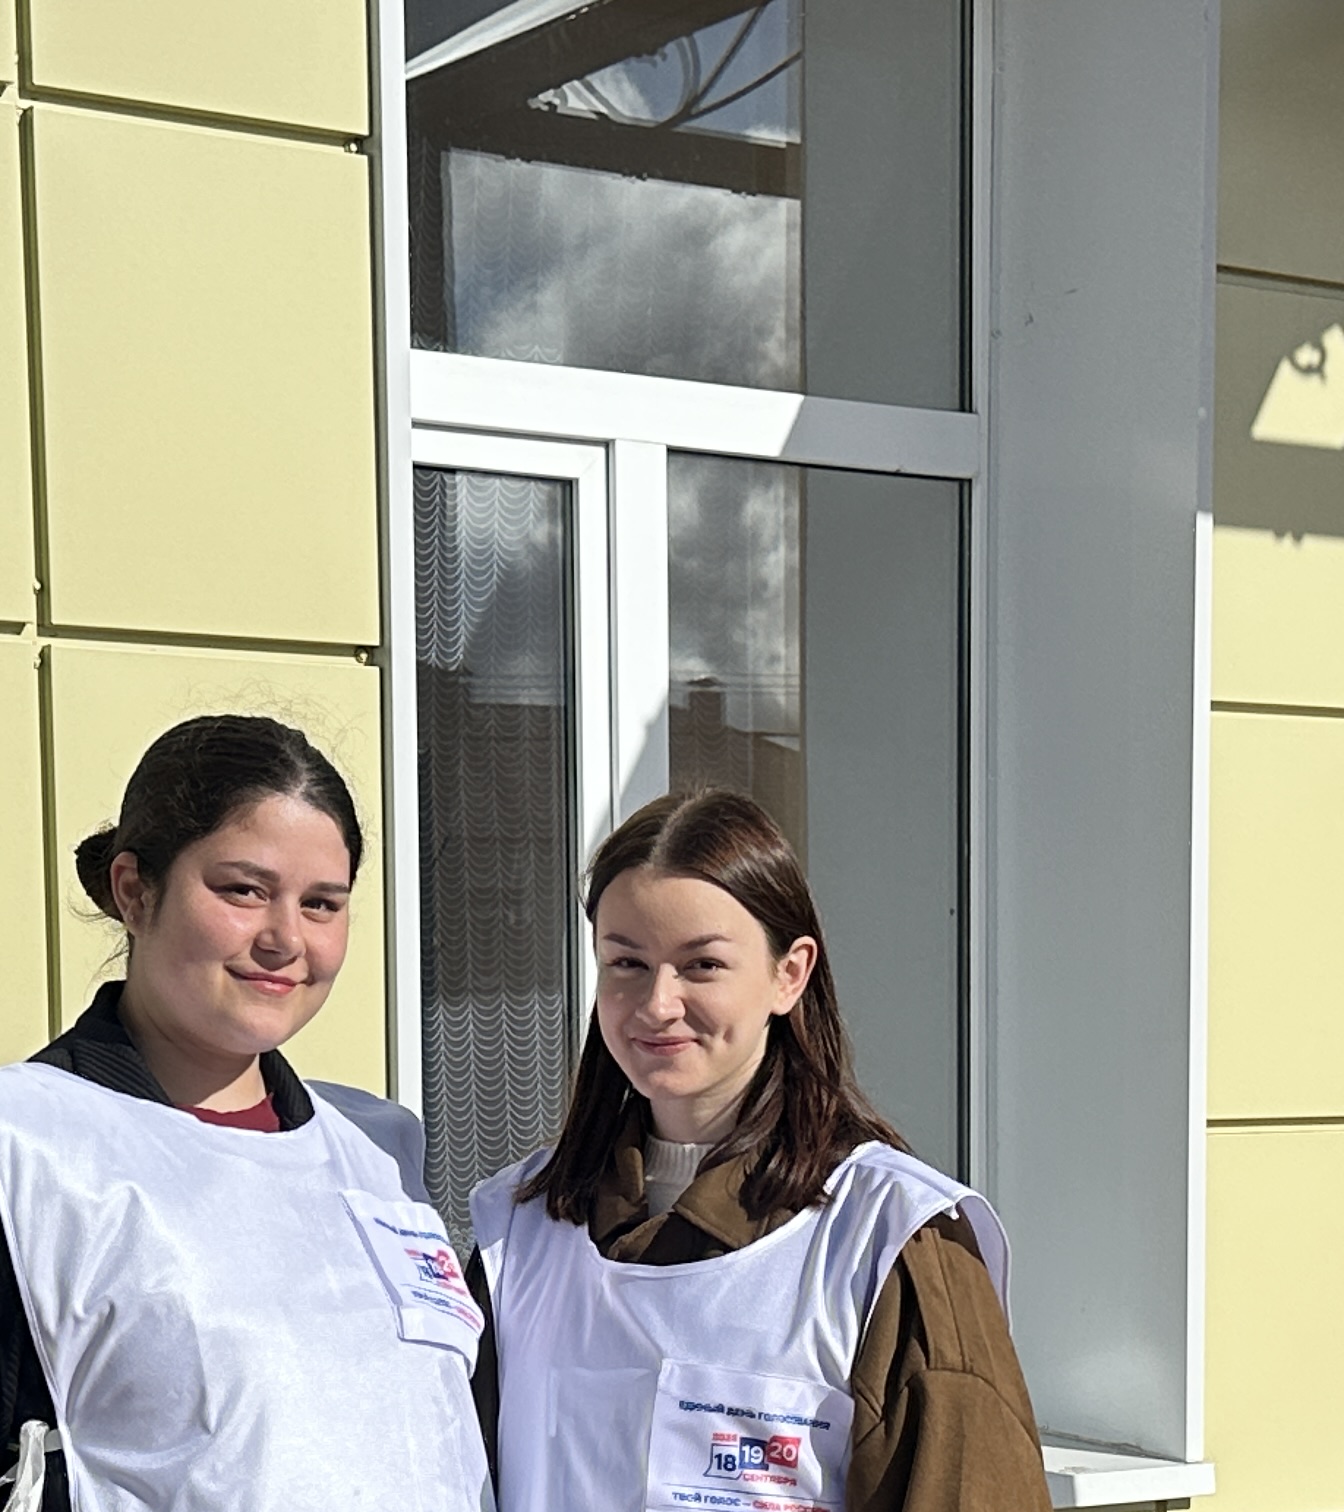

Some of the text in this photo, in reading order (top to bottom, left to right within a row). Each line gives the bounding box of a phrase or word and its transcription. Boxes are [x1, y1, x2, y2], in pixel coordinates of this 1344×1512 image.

[713, 1442, 798, 1472] 18 19 20
